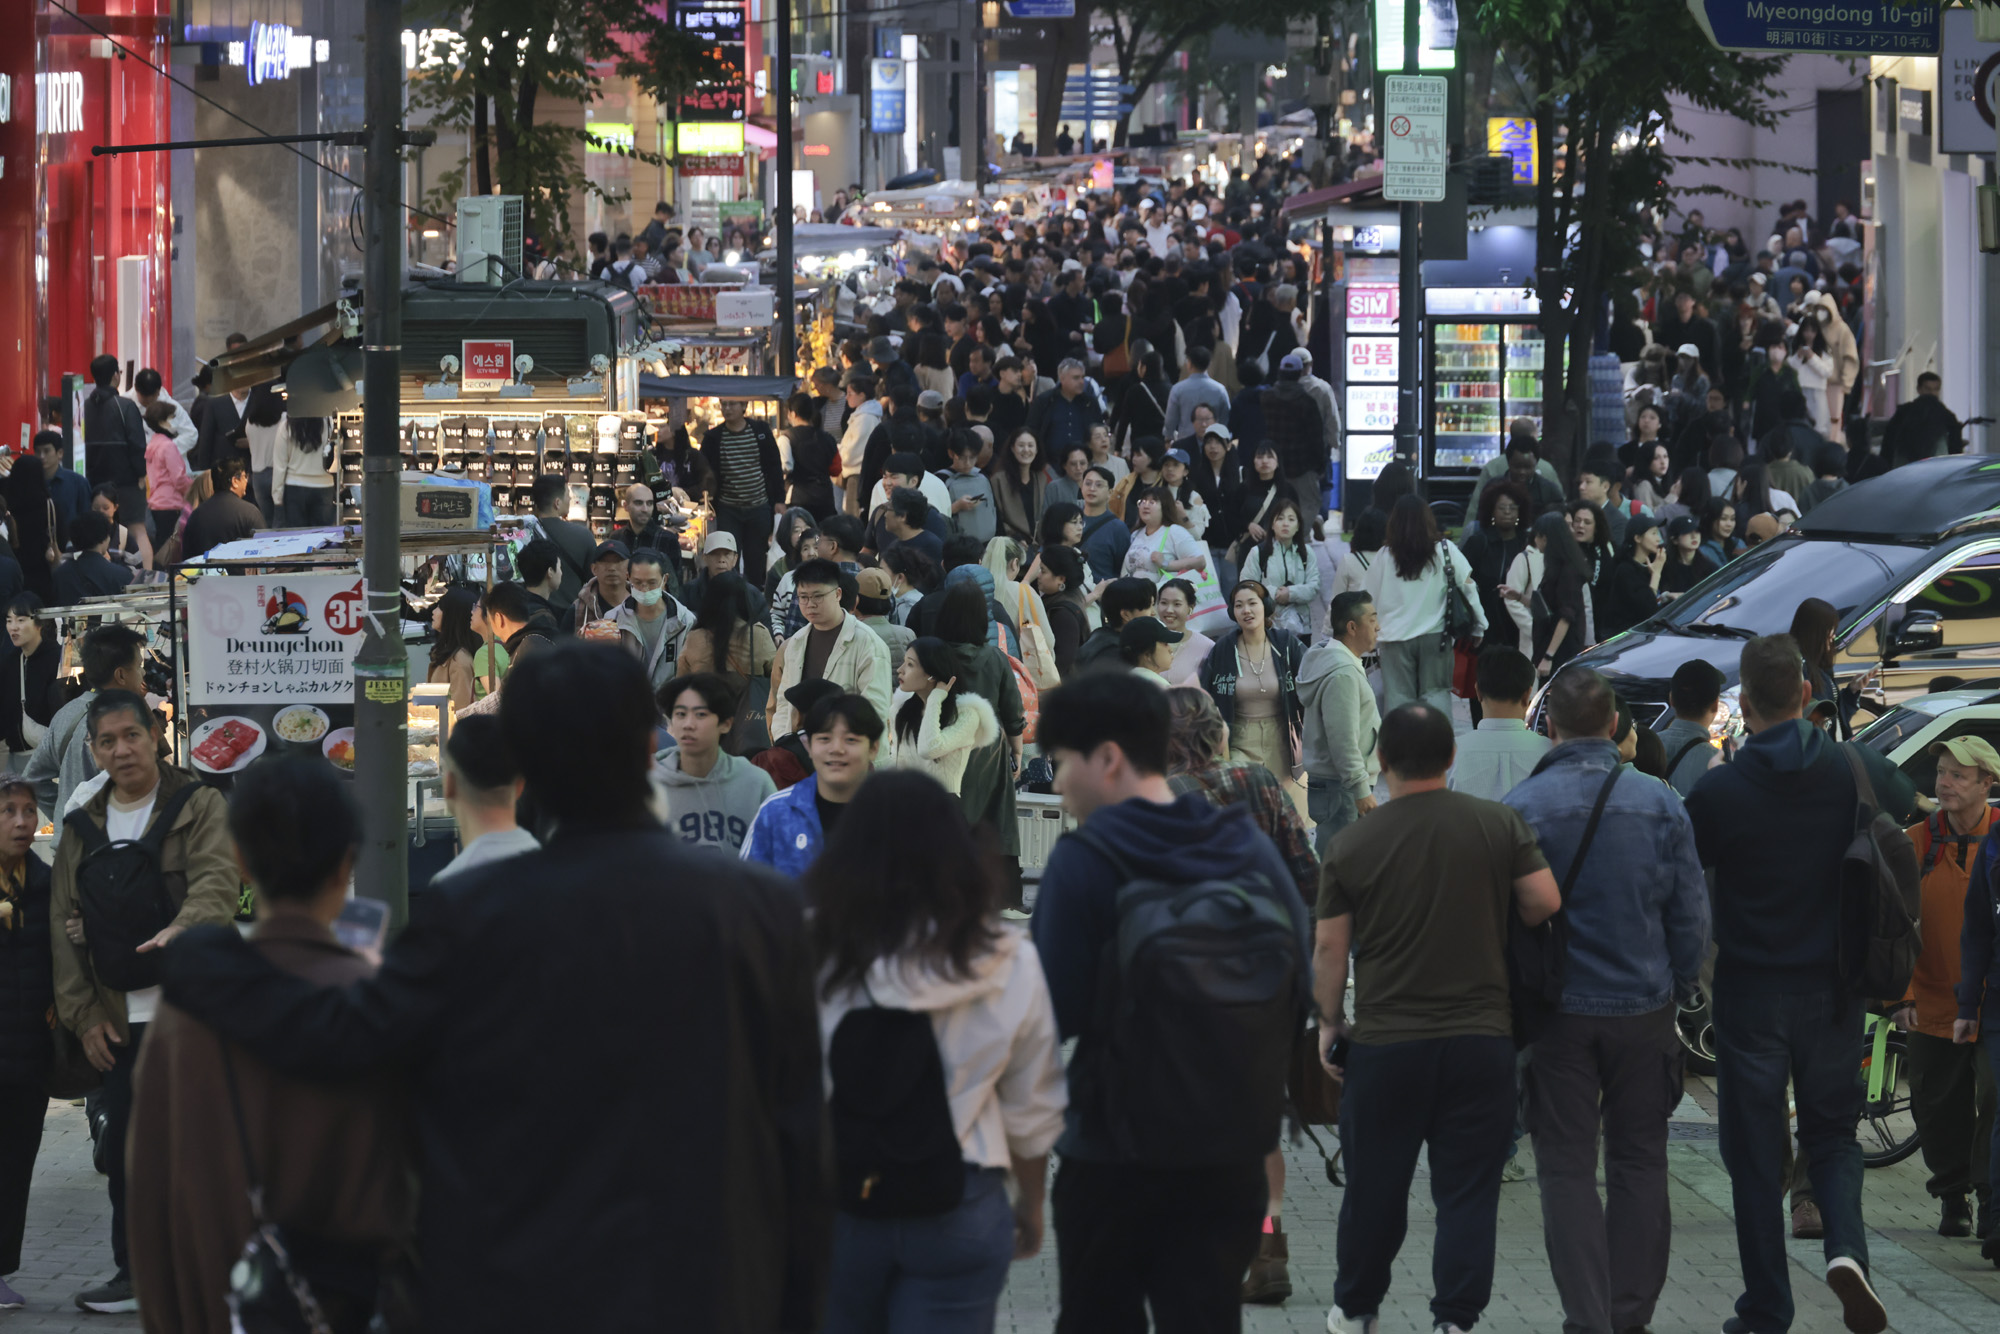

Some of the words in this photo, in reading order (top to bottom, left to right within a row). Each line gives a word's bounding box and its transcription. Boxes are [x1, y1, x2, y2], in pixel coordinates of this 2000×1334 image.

[1747, 2, 1873, 25] Myeongdong
[1881, 6, 1933, 26] 10-gil
[1766, 31, 1826, 46] 明洞10街
[1832, 34, 1932, 48] ミョンドン10ギル
[35, 71, 84, 134] TIRTIR
[1350, 296, 1387, 314] SIM
[472, 354, 504, 367] 에스원
[1352, 344, 1393, 365] 상품
[226, 636, 344, 656] Deungchon
[227, 658, 344, 675] 登村火锅刀切面
[205, 681, 354, 694] ドゥンチョンしゃぶカルグク
